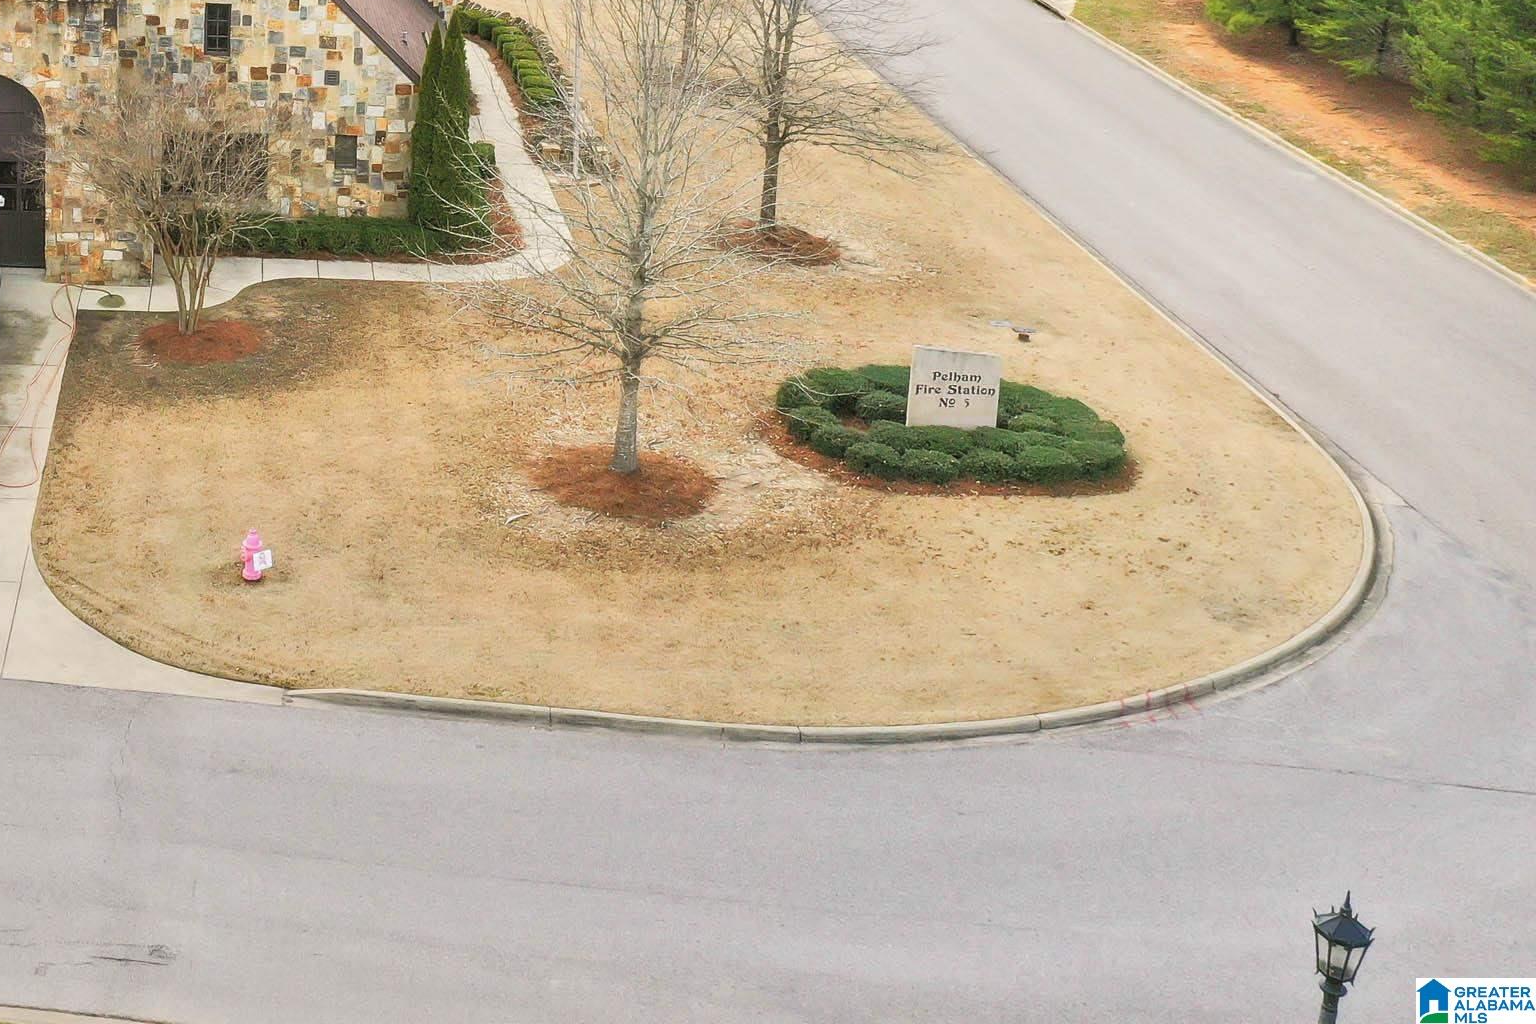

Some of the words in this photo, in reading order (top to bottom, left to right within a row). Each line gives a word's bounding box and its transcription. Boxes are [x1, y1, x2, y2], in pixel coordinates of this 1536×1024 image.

[932, 371, 982, 383] Pelham
[915, 384, 942, 396] Fire
[947, 384, 996, 396] Station
[964, 398, 970, 409] 5
